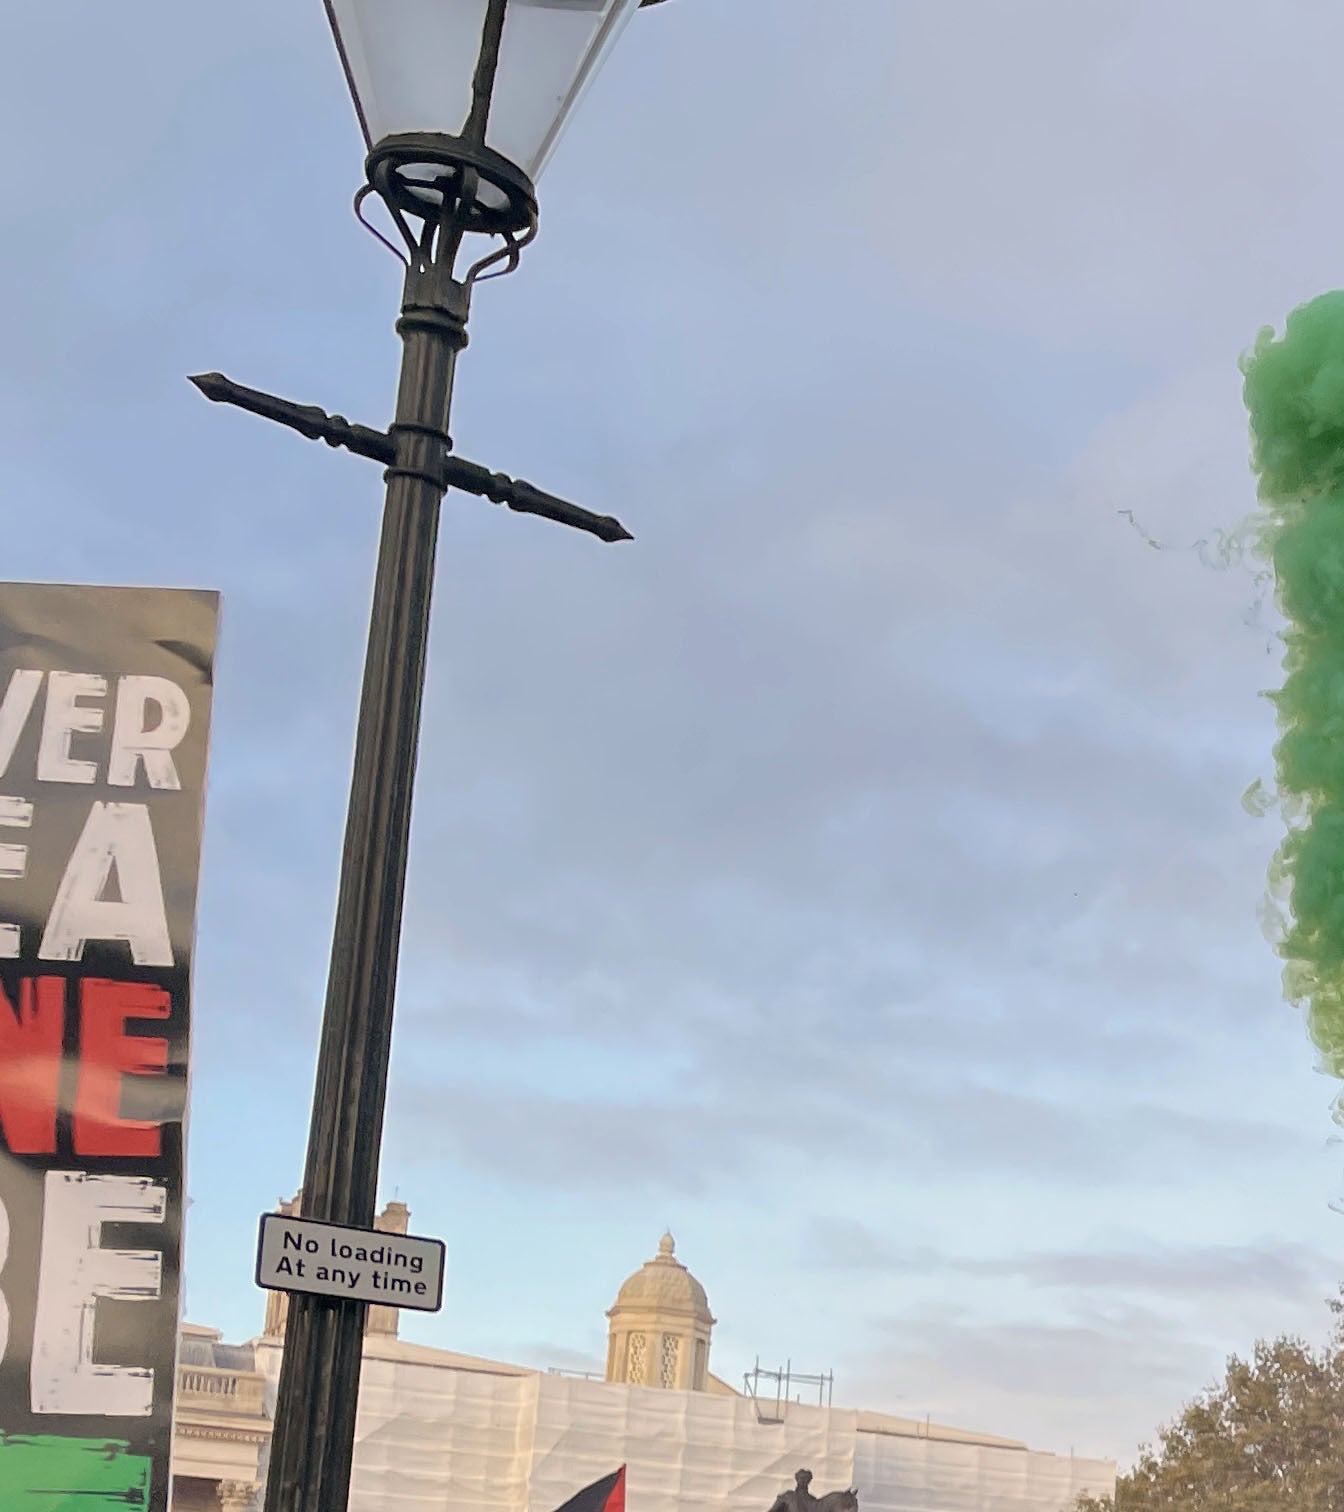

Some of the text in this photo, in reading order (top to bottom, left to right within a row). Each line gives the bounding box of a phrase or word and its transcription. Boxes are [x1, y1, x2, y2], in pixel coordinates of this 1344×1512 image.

[283, 1231, 423, 1274] No loading
[276, 1256, 427, 1295] At any time
